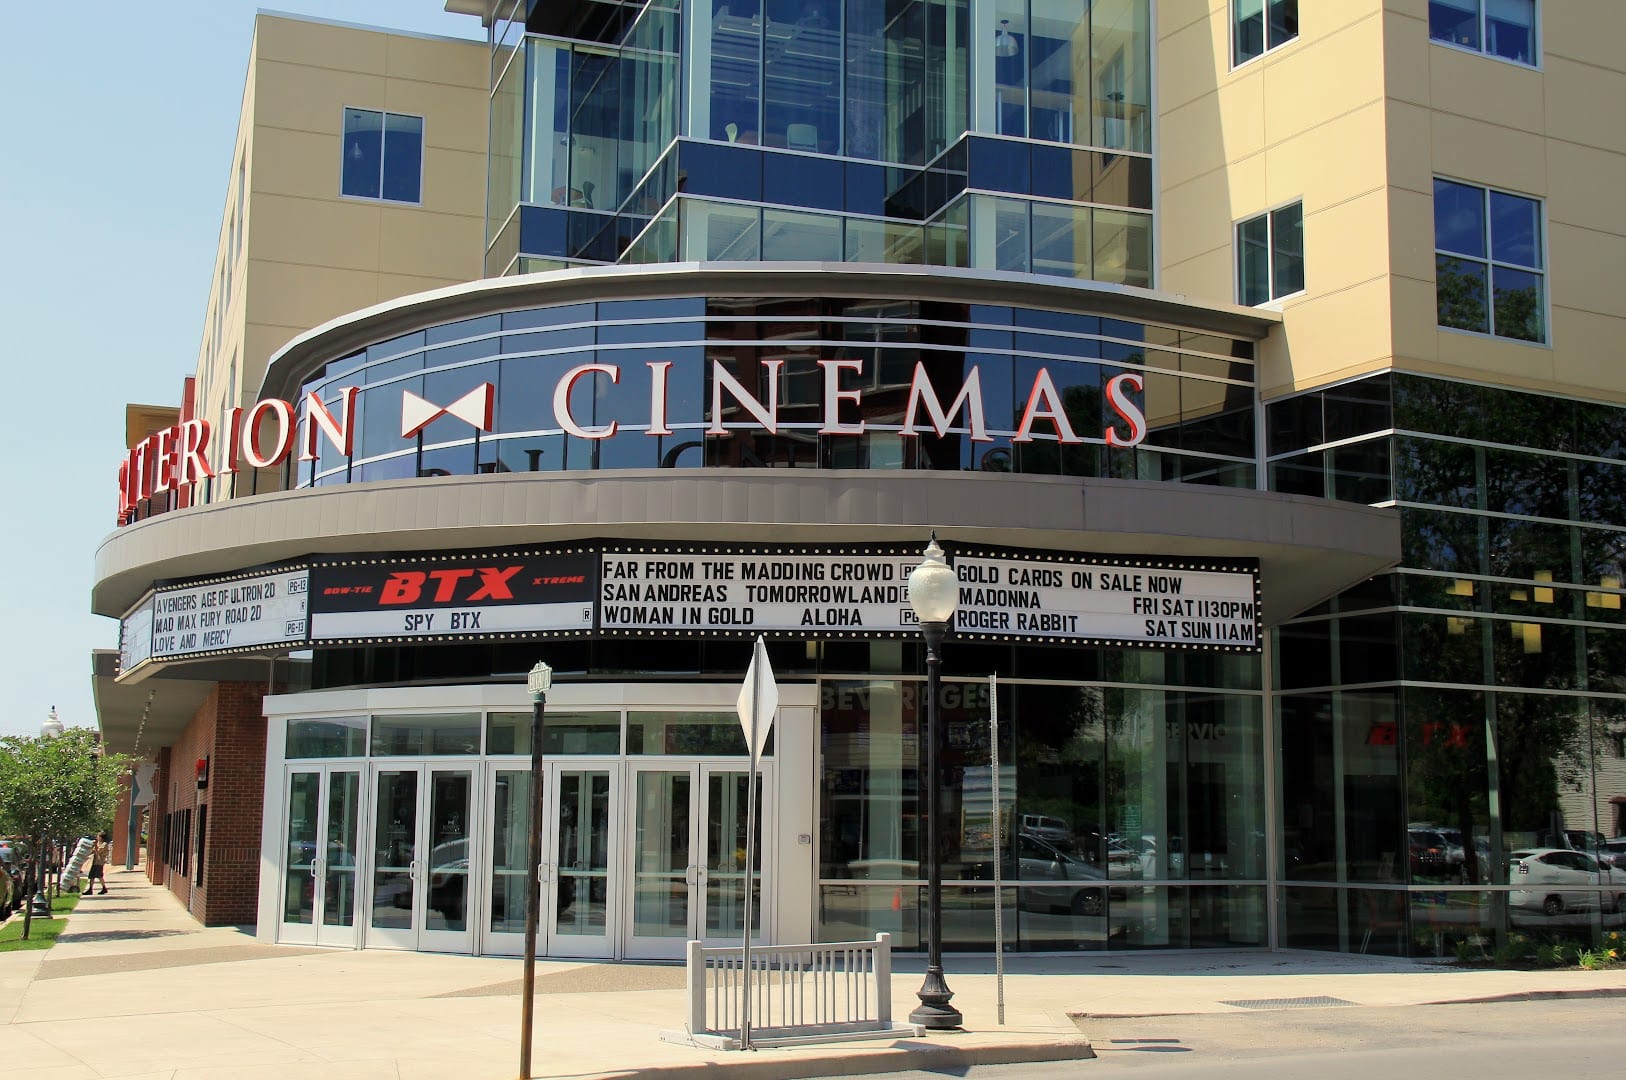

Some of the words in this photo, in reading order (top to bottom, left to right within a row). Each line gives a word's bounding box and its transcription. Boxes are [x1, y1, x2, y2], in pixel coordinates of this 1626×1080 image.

[553, 359, 1148, 448] CINEMAS
[532, 576, 586, 585] XTREME
[603, 561, 638, 580] FAR
[646, 562, 694, 580] FROM
[702, 563, 735, 580] THE
[741, 563, 825, 580] MADDING
[830, 564, 894, 581] CROWD
[957, 565, 999, 584] GOLD
[1008, 568, 1063, 588] CARDS
[1071, 571, 1092, 589] ON
[1101, 573, 1142, 592] SALE
[1149, 576, 1182, 594] NOW
[289, 579, 307, 593] PG-13
[323, 586, 373, 595] BOW-TIE
[378, 565, 525, 605] BTX
[603, 584, 641, 601] SAN
[644, 584, 728, 602] ANDREAS
[746, 585, 898, 604] TOMORROWLAND
[157, 594, 197, 615] AVENGERS
[201, 591, 217, 608] AGE
[219, 589, 229, 605] OF
[231, 586, 262, 604] ULTRON
[265, 581, 276, 599] 2D
[959, 588, 1041, 609] MADONNA
[1133, 597, 1158, 614] FRI
[1162, 599, 1194, 617] SAT
[155, 618, 174, 634] MAD
[178, 613, 197, 631] MAX
[200, 612, 221, 628] FURY
[226, 607, 248, 624] ROAD
[251, 604, 262, 621] 2D
[404, 614, 435, 631] SPY
[450, 611, 481, 630] BTX
[583, 610, 590, 621] R
[604, 607, 674, 625] WOMAN
[682, 607, 701, 625] IN
[708, 608, 754, 625] GOLD
[801, 608, 863, 626] ALOHA
[957, 610, 1010, 630] ROGER
[1017, 613, 1078, 633] RABBIT
[288, 620, 305, 634] PG-13
[1146, 620, 1178, 637] SAT
[1182, 622, 1212, 639] SUN
[154, 635, 175, 652] LOVE
[180, 633, 197, 649] AND
[203, 629, 231, 647] MERCY
